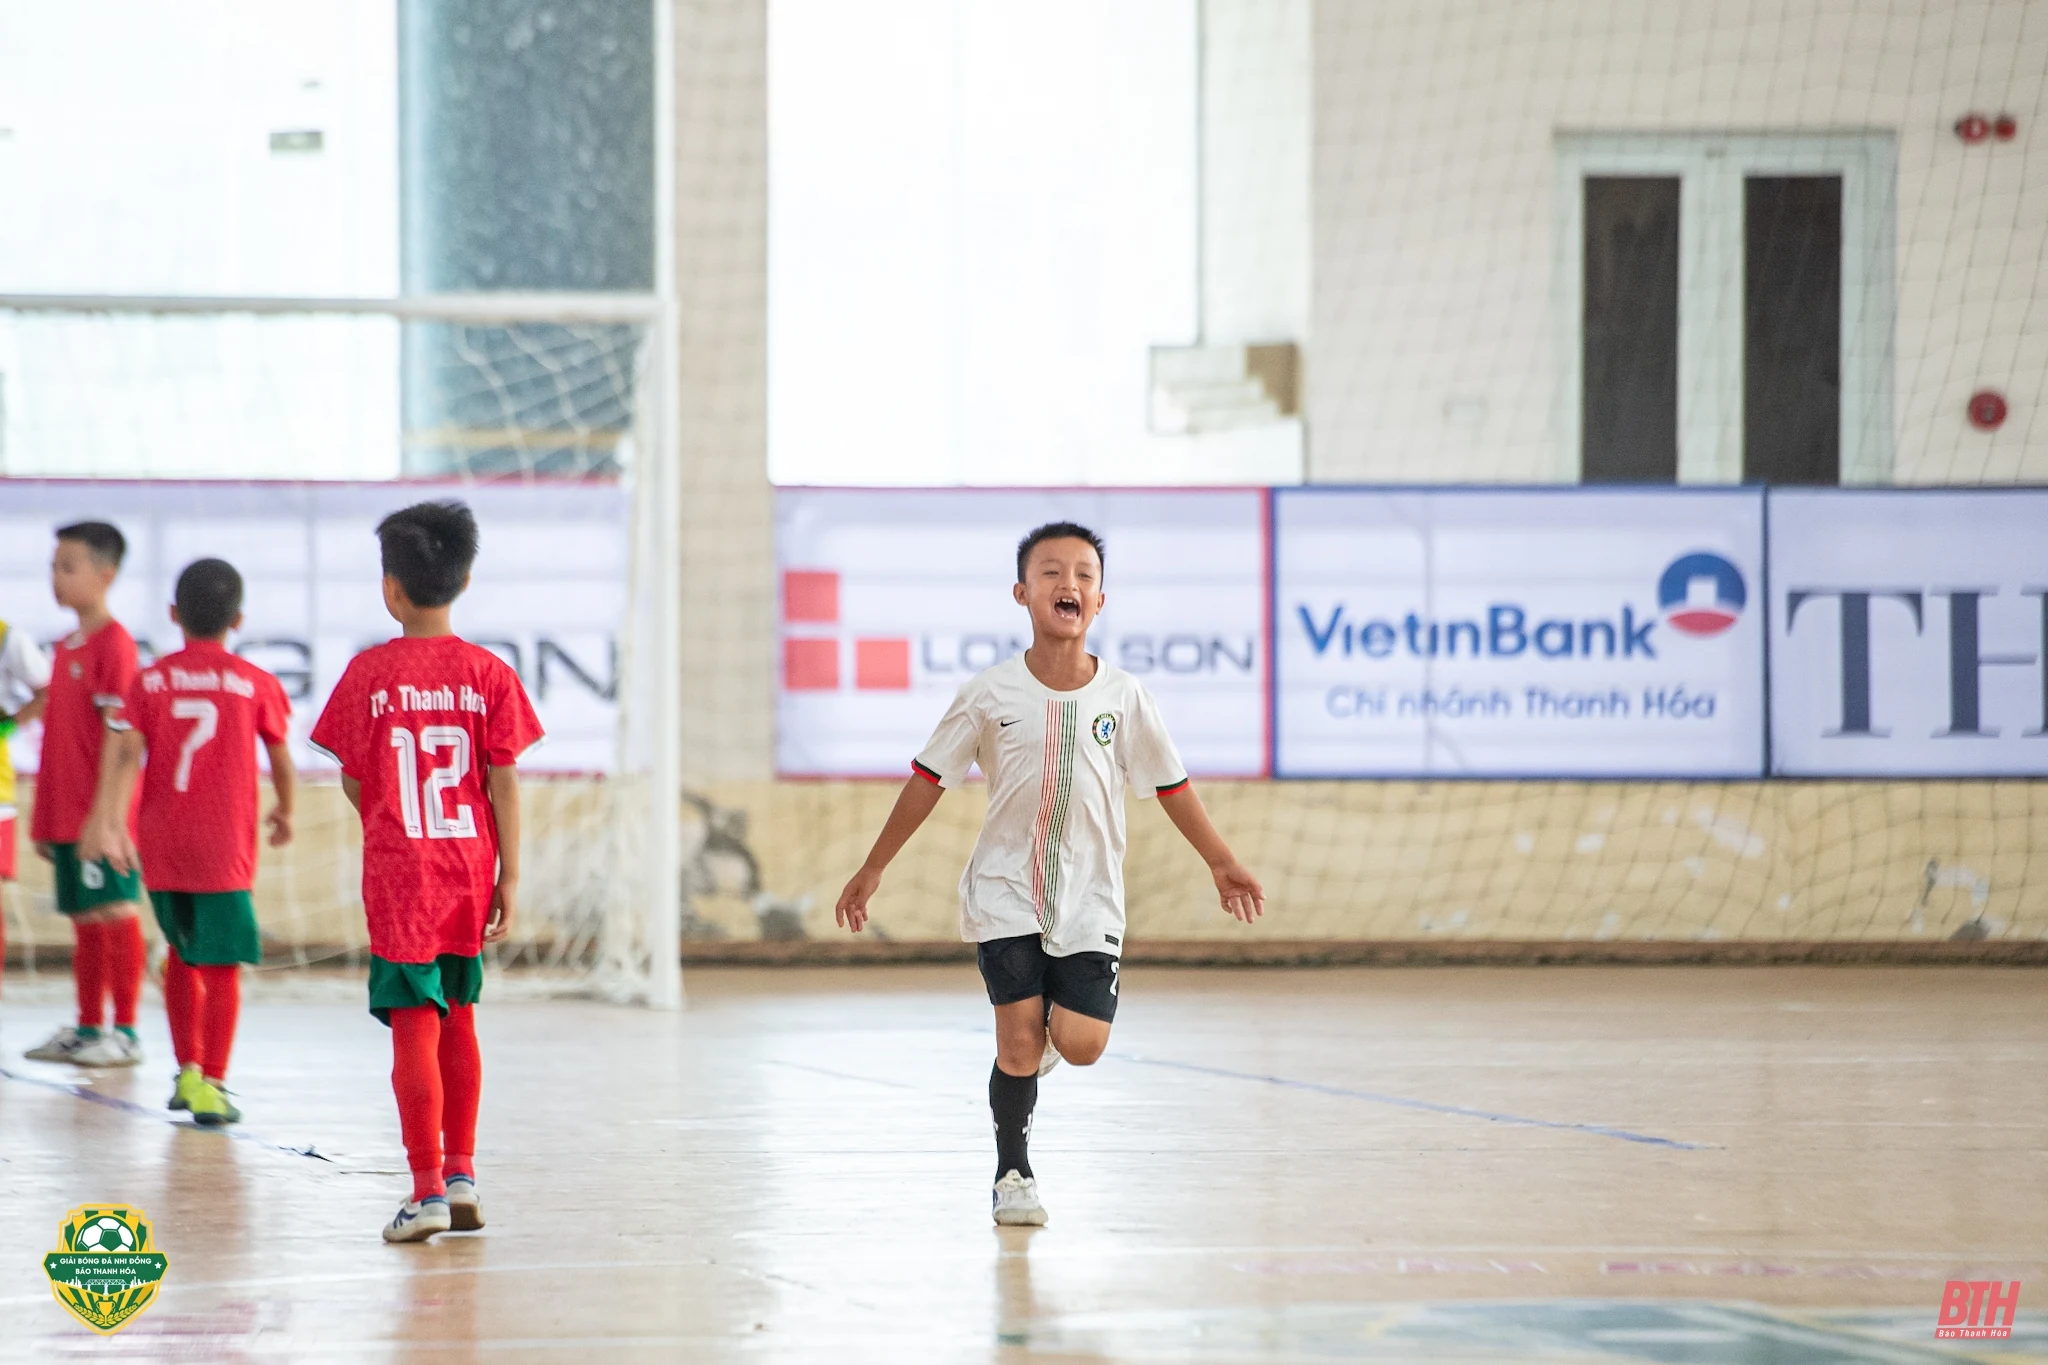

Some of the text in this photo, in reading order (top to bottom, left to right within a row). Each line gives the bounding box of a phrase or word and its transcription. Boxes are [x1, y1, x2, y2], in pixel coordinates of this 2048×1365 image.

[1296, 603, 1657, 657] VietinBank
[1120, 635, 1255, 675] SON
[369, 689, 395, 719] TP.
[398, 684, 455, 711] Thanh
[1325, 684, 1388, 719] Chi
[1396, 684, 1514, 719] nhánh
[1524, 685, 1631, 719] Thanh
[170, 696, 219, 793] 7
[391, 725, 478, 839] 12
